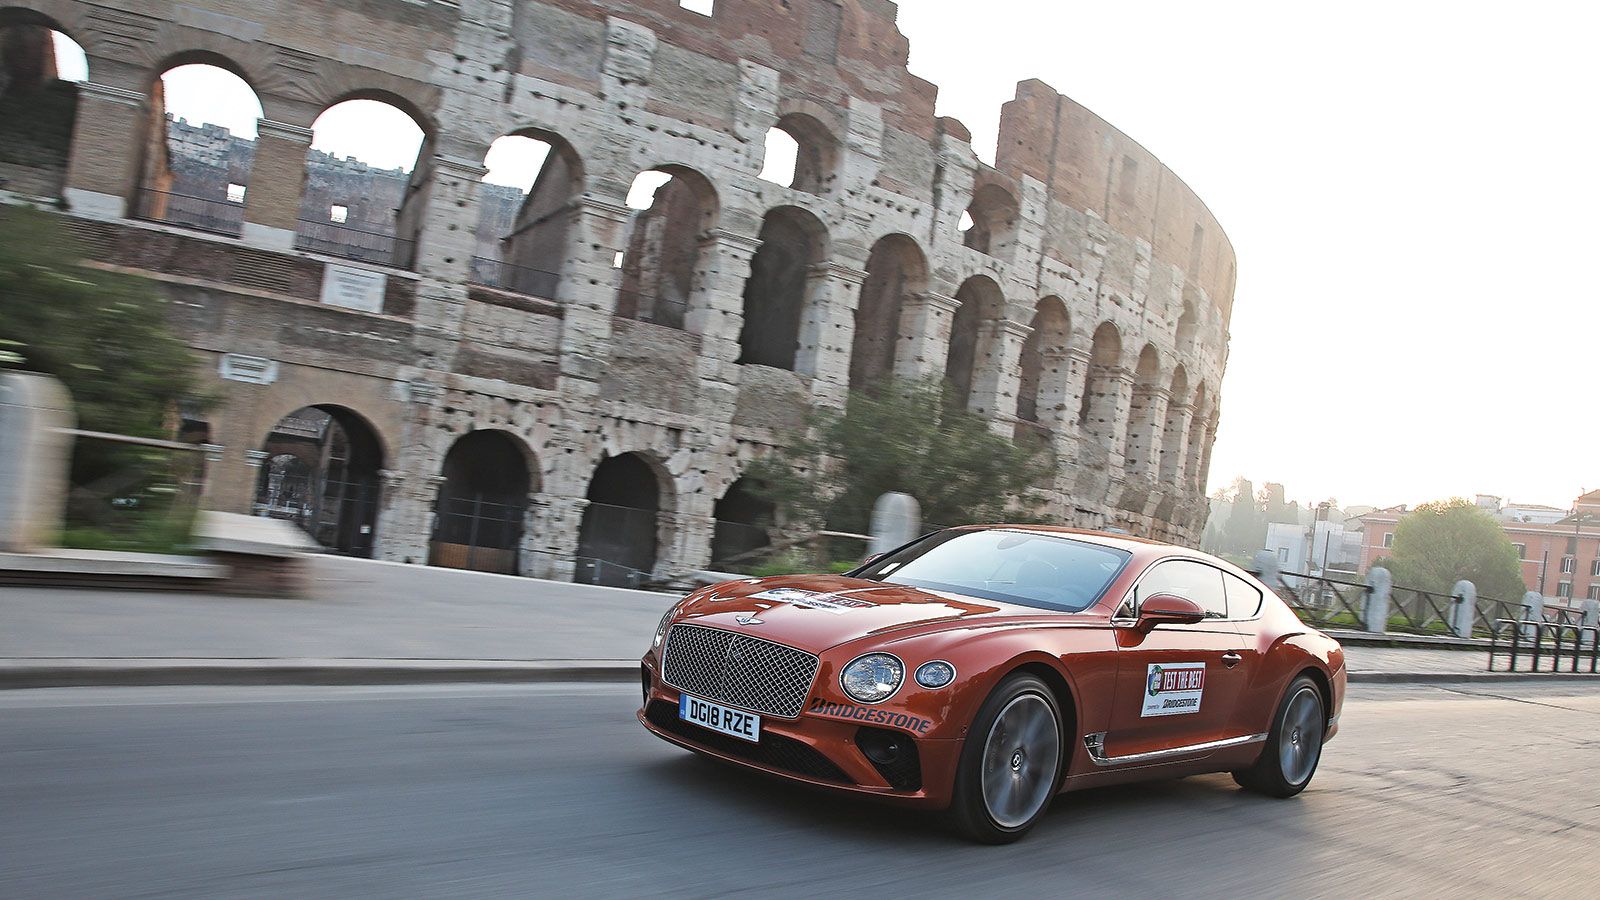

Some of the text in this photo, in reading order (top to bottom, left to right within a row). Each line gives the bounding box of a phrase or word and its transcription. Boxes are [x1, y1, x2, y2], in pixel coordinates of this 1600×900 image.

[1164, 671, 1177, 690] TEST
[1177, 671, 1188, 689] THE
[1188, 671, 1202, 688] BEST
[808, 697, 931, 734] BRIDGESTONE
[1162, 698, 1198, 709] BRIDGESTONE
[690, 700, 754, 736] DG18 RZE
